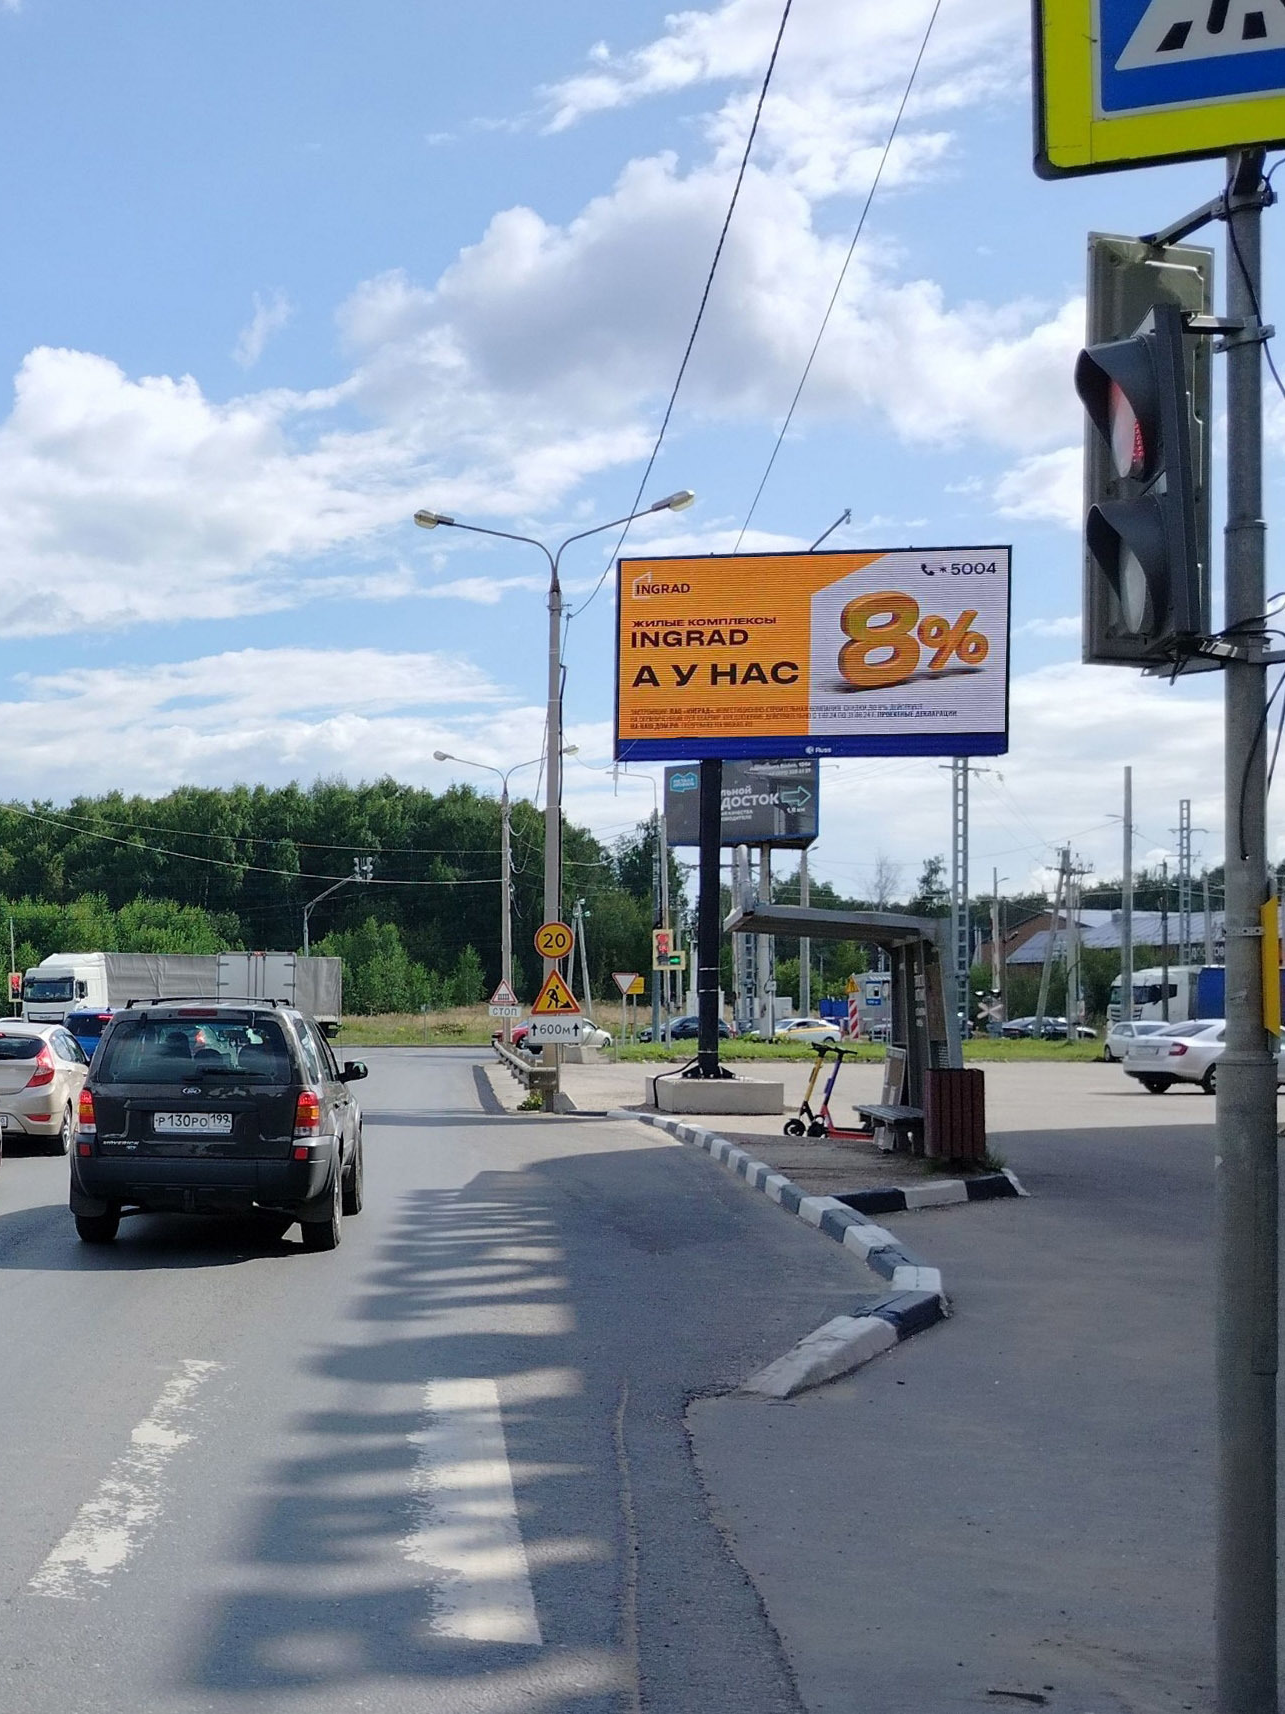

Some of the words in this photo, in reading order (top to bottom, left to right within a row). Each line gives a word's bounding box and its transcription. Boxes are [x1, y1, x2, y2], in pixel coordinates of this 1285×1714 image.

[636, 583, 690, 594] INGRAD
[632, 619, 685, 627] ЖИЛЫЕ
[688, 617, 777, 626] КОМПЛЕКСЫ
[631, 629, 749, 648] INGRAD
[838, 590, 989, 687] 8%
[632, 665, 661, 687] А
[671, 664, 698, 686] У
[710, 661, 799, 686] НАС
[543, 933, 566, 948] 20
[210, 1113, 229, 1124] 199
